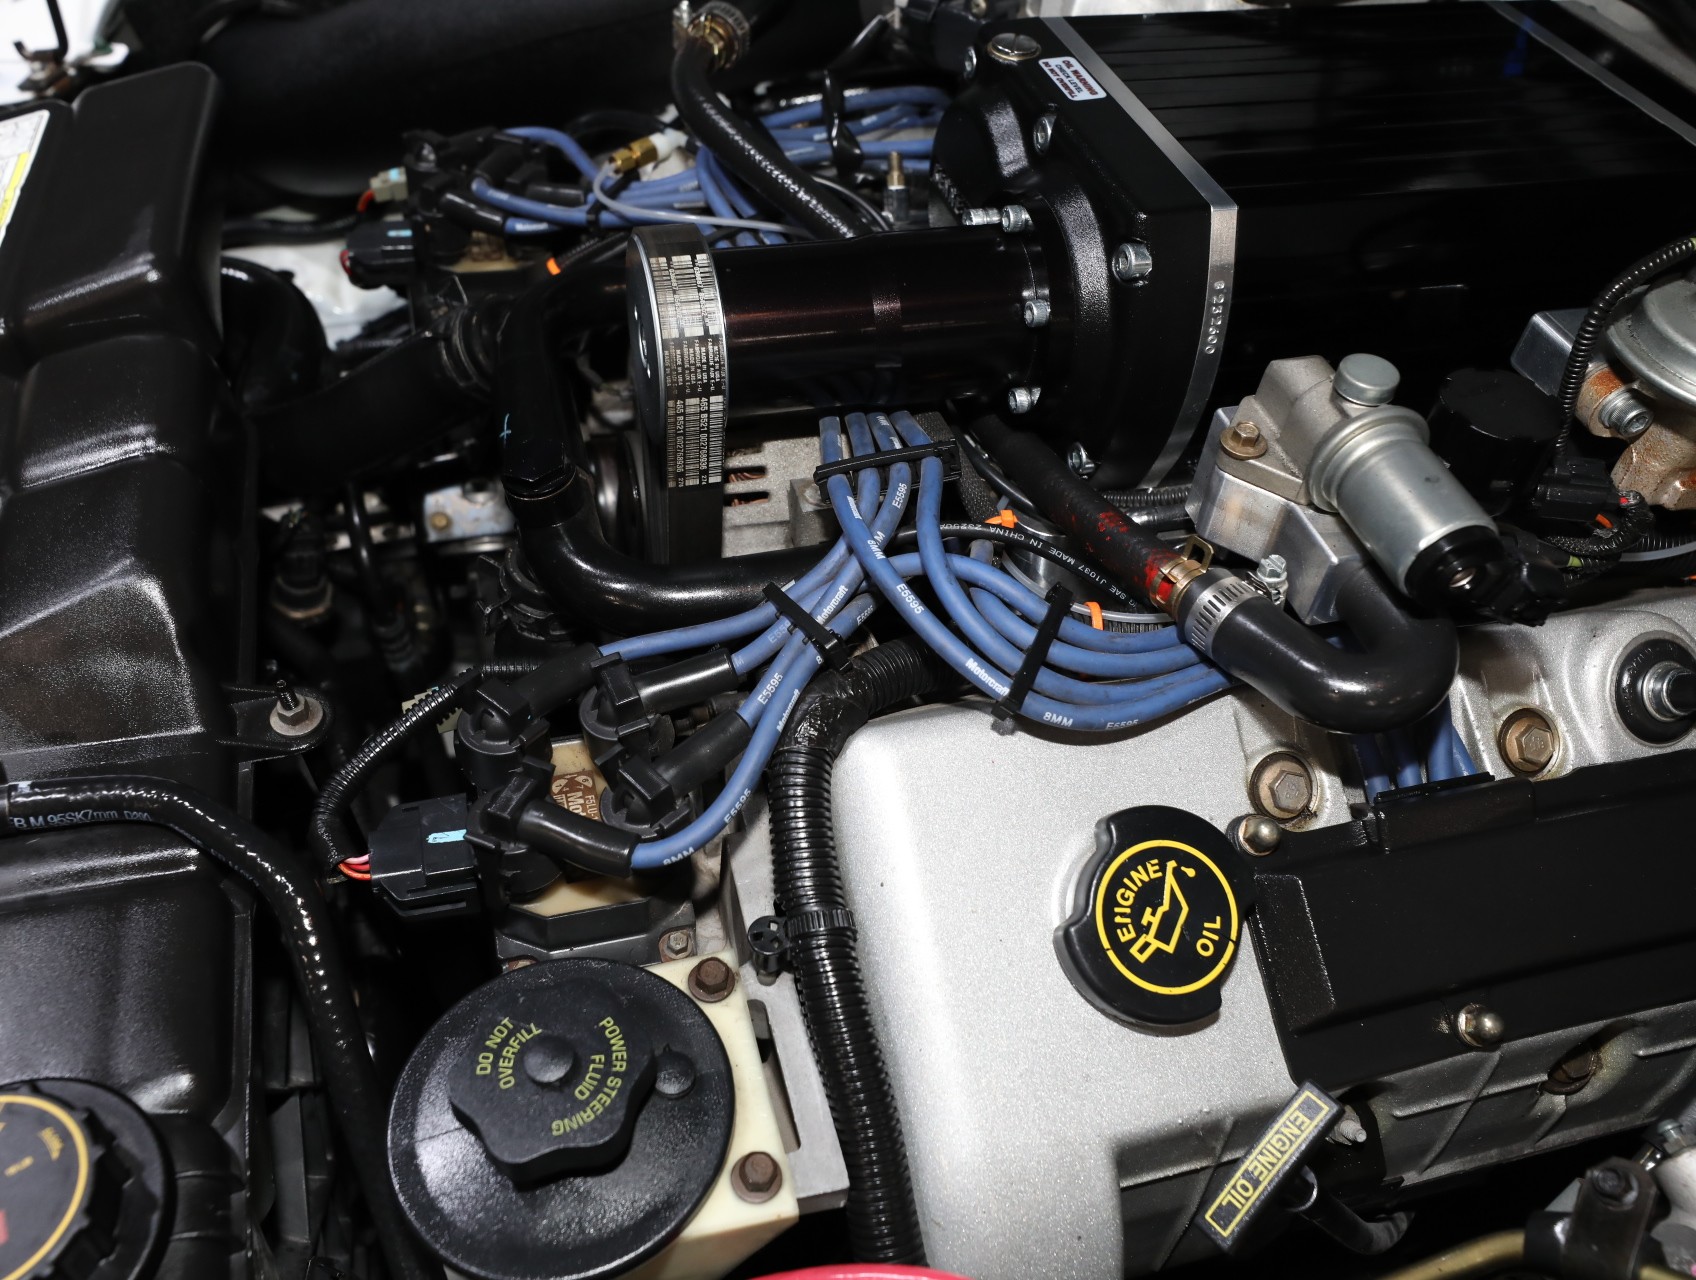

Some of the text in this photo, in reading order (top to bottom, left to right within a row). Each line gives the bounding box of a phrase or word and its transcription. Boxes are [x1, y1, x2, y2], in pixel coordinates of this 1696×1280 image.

[1055, 64, 1084, 93] CHECK LEVEL
[1062, 60, 1099, 95] OIL WARNING
[700, 397, 709, 411] 465
[700, 413, 708, 431] B521
[892, 482, 908, 509] E5595
[989, 525, 1025, 541] CHINA
[1029, 538, 1043, 549] IN
[1048, 546, 1076, 564] MADE
[1078, 564, 1107, 585] J1037
[1109, 584, 1127, 600] SAE
[815, 584, 849, 626] Motorcraft
[867, 540, 886, 560] 8MM
[896, 583, 924, 614] E5595
[1043, 711, 1074, 728] 8MM
[757, 673, 783, 705] E5595
[723, 788, 752, 824] E5595
[776, 688, 800, 732] Motorcraft
[1114, 859, 1163, 943] ENGINE
[1196, 915, 1221, 957] OIL
[476, 1017, 516, 1075] DO NOT
[498, 1022, 543, 1090] OVERFILL
[551, 1016, 627, 1136] POWER STEERING
[574, 1054, 605, 1100] FLUID
[1221, 1109, 1312, 1210] ENGINE OIL
